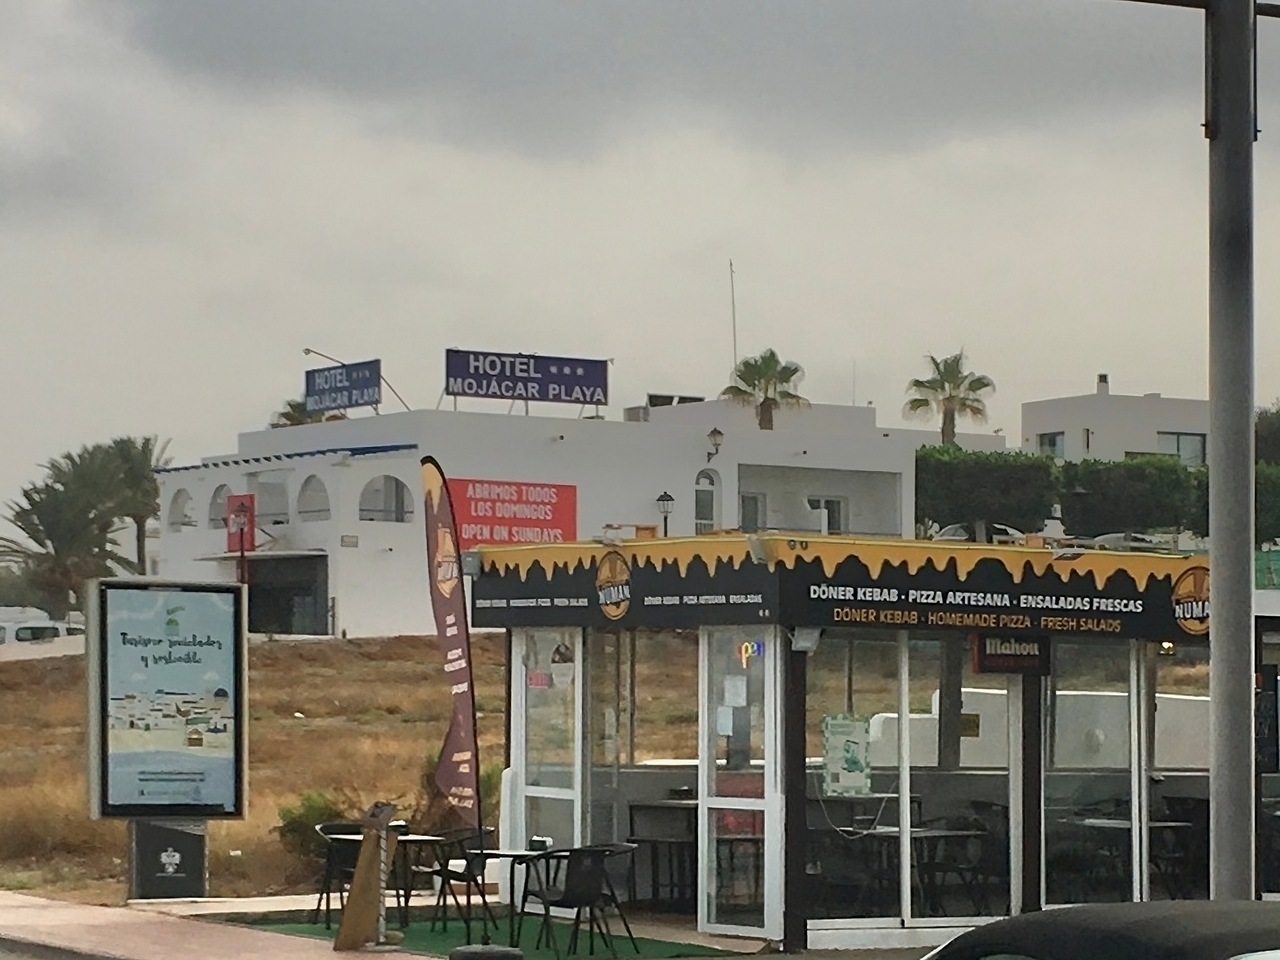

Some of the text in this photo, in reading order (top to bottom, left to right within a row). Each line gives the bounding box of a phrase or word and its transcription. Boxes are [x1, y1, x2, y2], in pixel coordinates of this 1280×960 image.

[469, 354, 542, 378] HOTEL
[314, 368, 350, 390] HOTEL
[449, 376, 606, 403] MOJÁCAR PLAYA
[466, 483, 558, 503] ABRIMOS TODOS
[470, 501, 553, 520] LOS DOMINGOS
[461, 523, 563, 543] OPEN ON SUNDAYS
[809, 583, 1143, 613] DÖNER KEBAB PIZZA ARTESANA ENSALADAS FRESCAS
[833, 607, 1121, 632] DÖNER KEBAB HOMEMADE PIZZA FRESH SALADS
[985, 638, 1040, 656] Mahou
